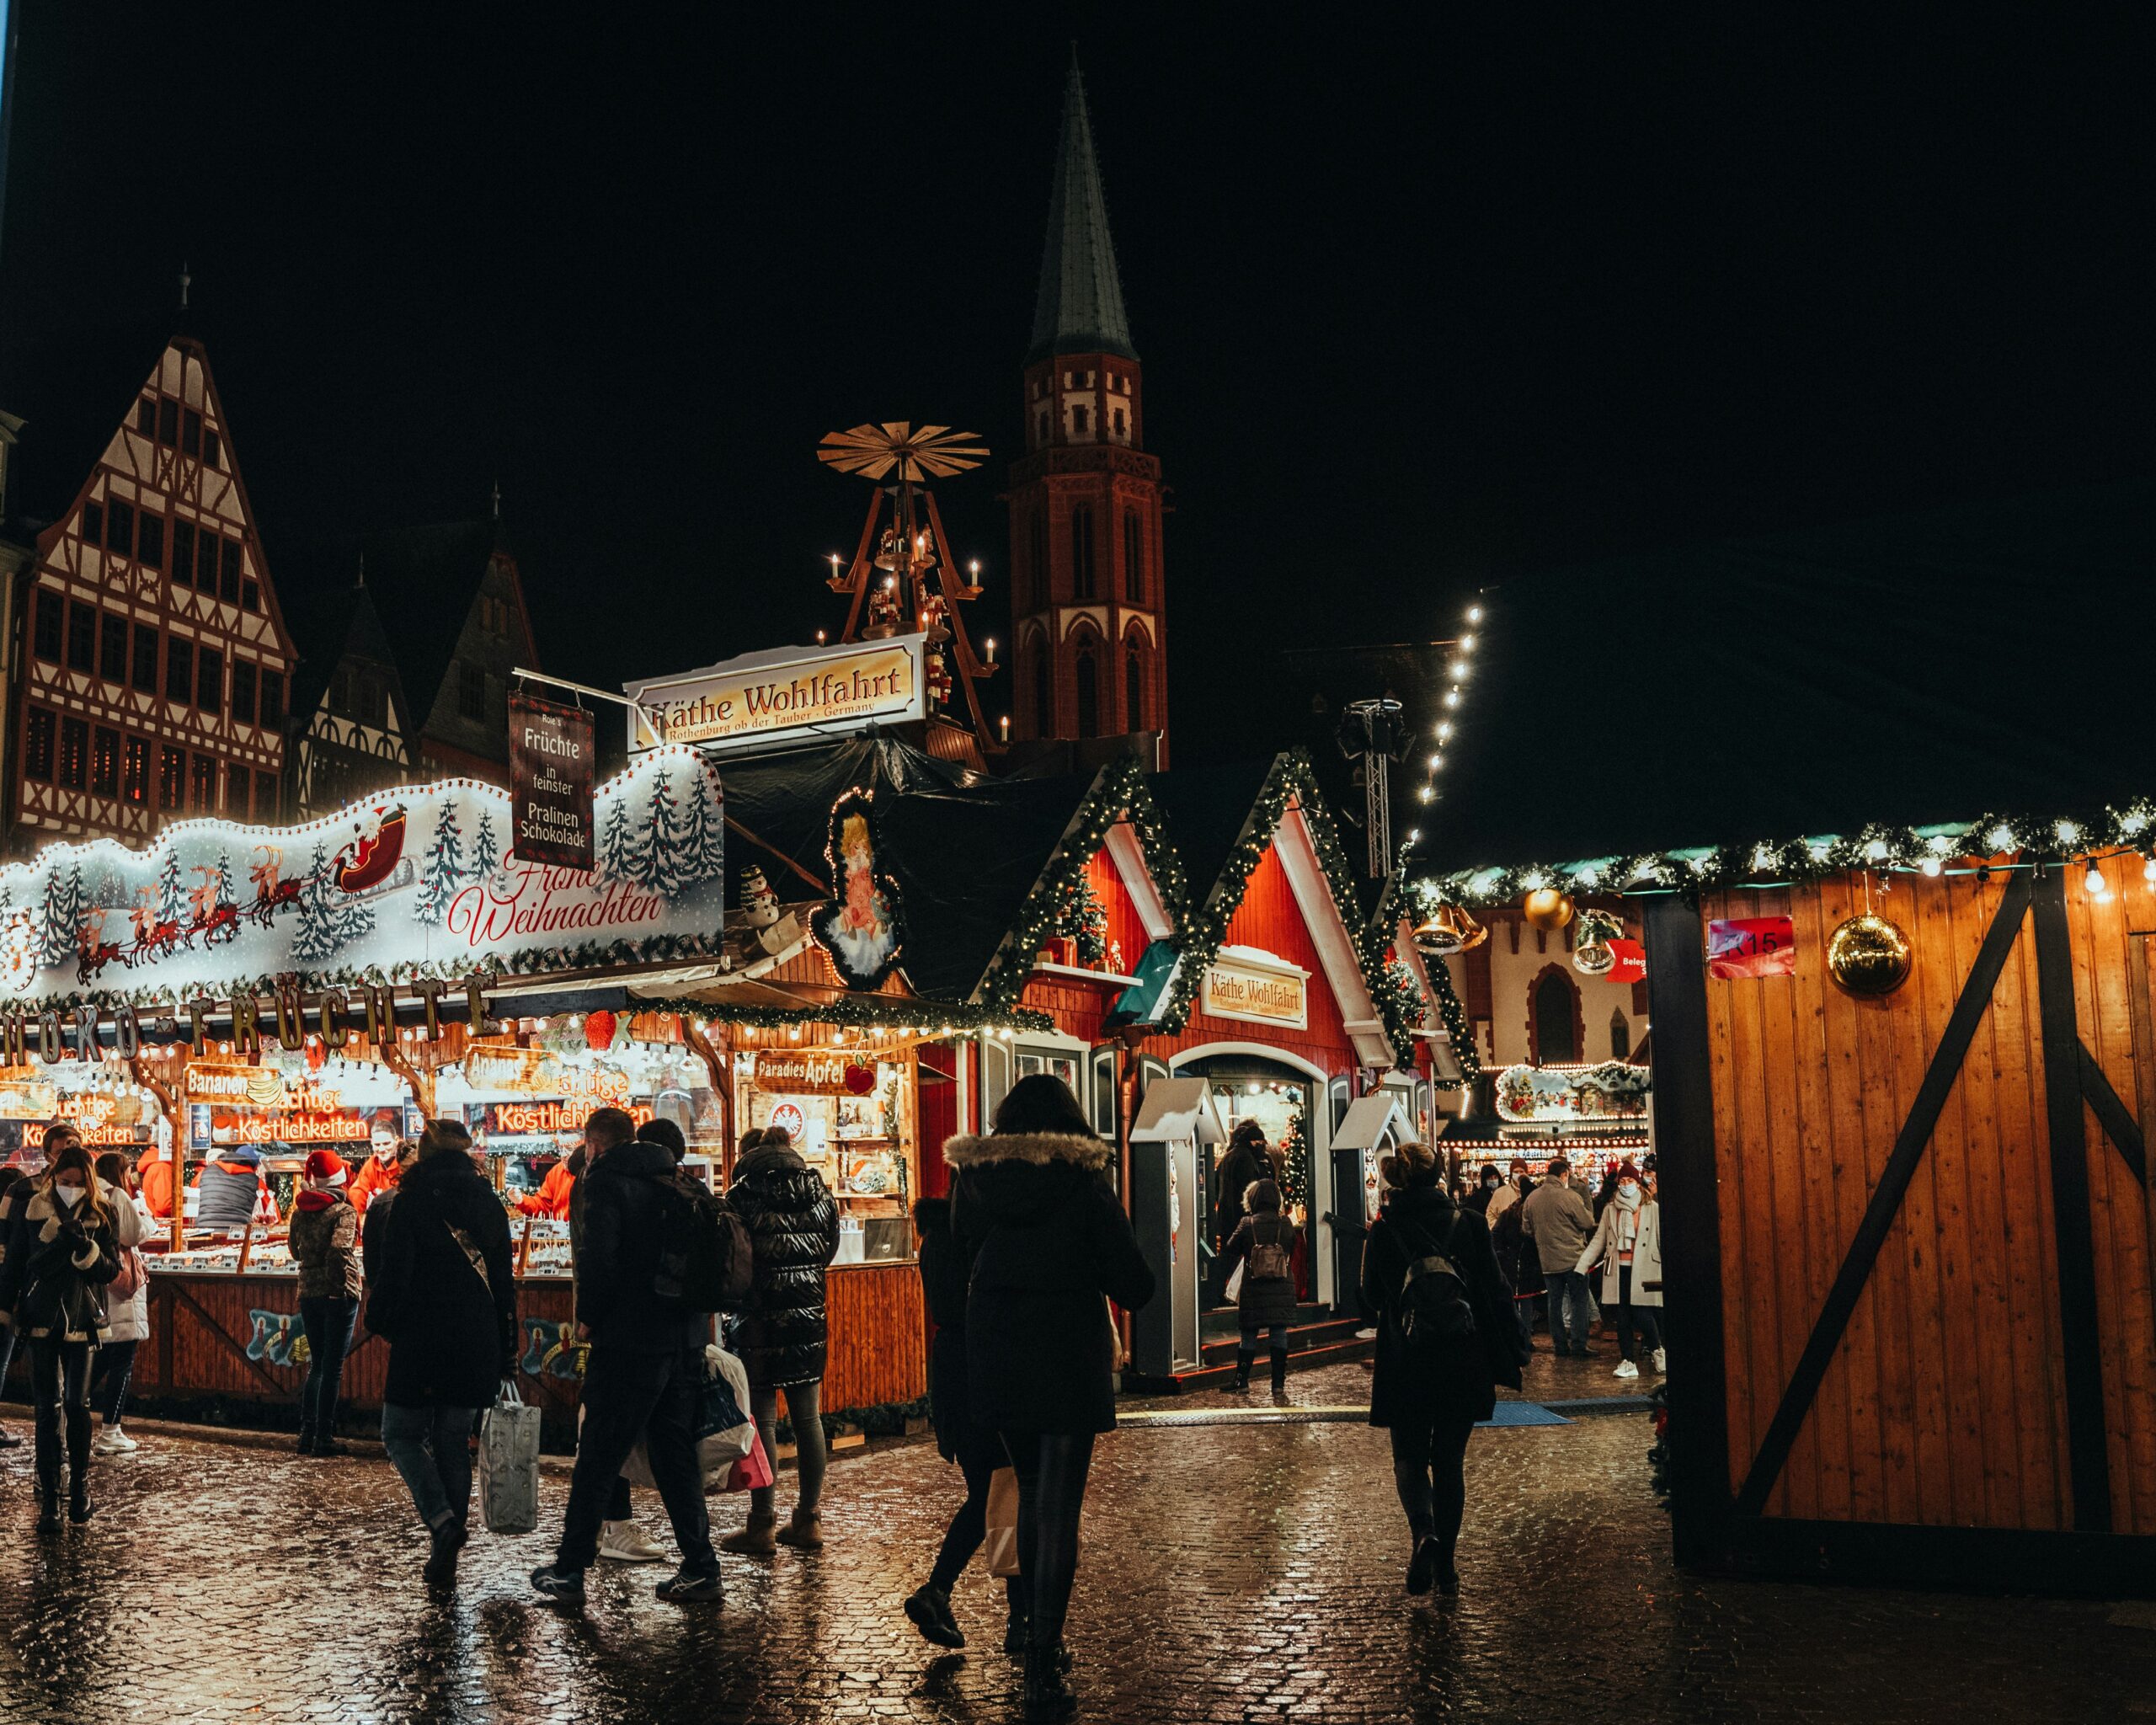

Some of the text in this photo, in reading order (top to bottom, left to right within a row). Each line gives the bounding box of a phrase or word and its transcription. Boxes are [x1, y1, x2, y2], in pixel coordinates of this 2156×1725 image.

[744, 668, 901, 717] Wohlfahrt
[670, 702, 874, 740] Rothenburg ob der Tauber Germany
[525, 728, 579, 759] Früchte
[533, 774, 573, 795] feinster
[547, 764, 556, 779] in
[528, 802, 578, 828] Pralinen
[520, 820, 585, 847] Schokolade
[448, 880, 662, 946] Weihnachten
[1211, 972, 1244, 1000] Käthe
[1247, 979, 1299, 1010] Wohlfahrt
[471, 1052, 521, 1081] Ananas
[759, 1054, 844, 1088] Paradies Äpfel
[188, 1069, 248, 1095] Bananen
[237, 1118, 369, 1143] Köstlichkeiten
